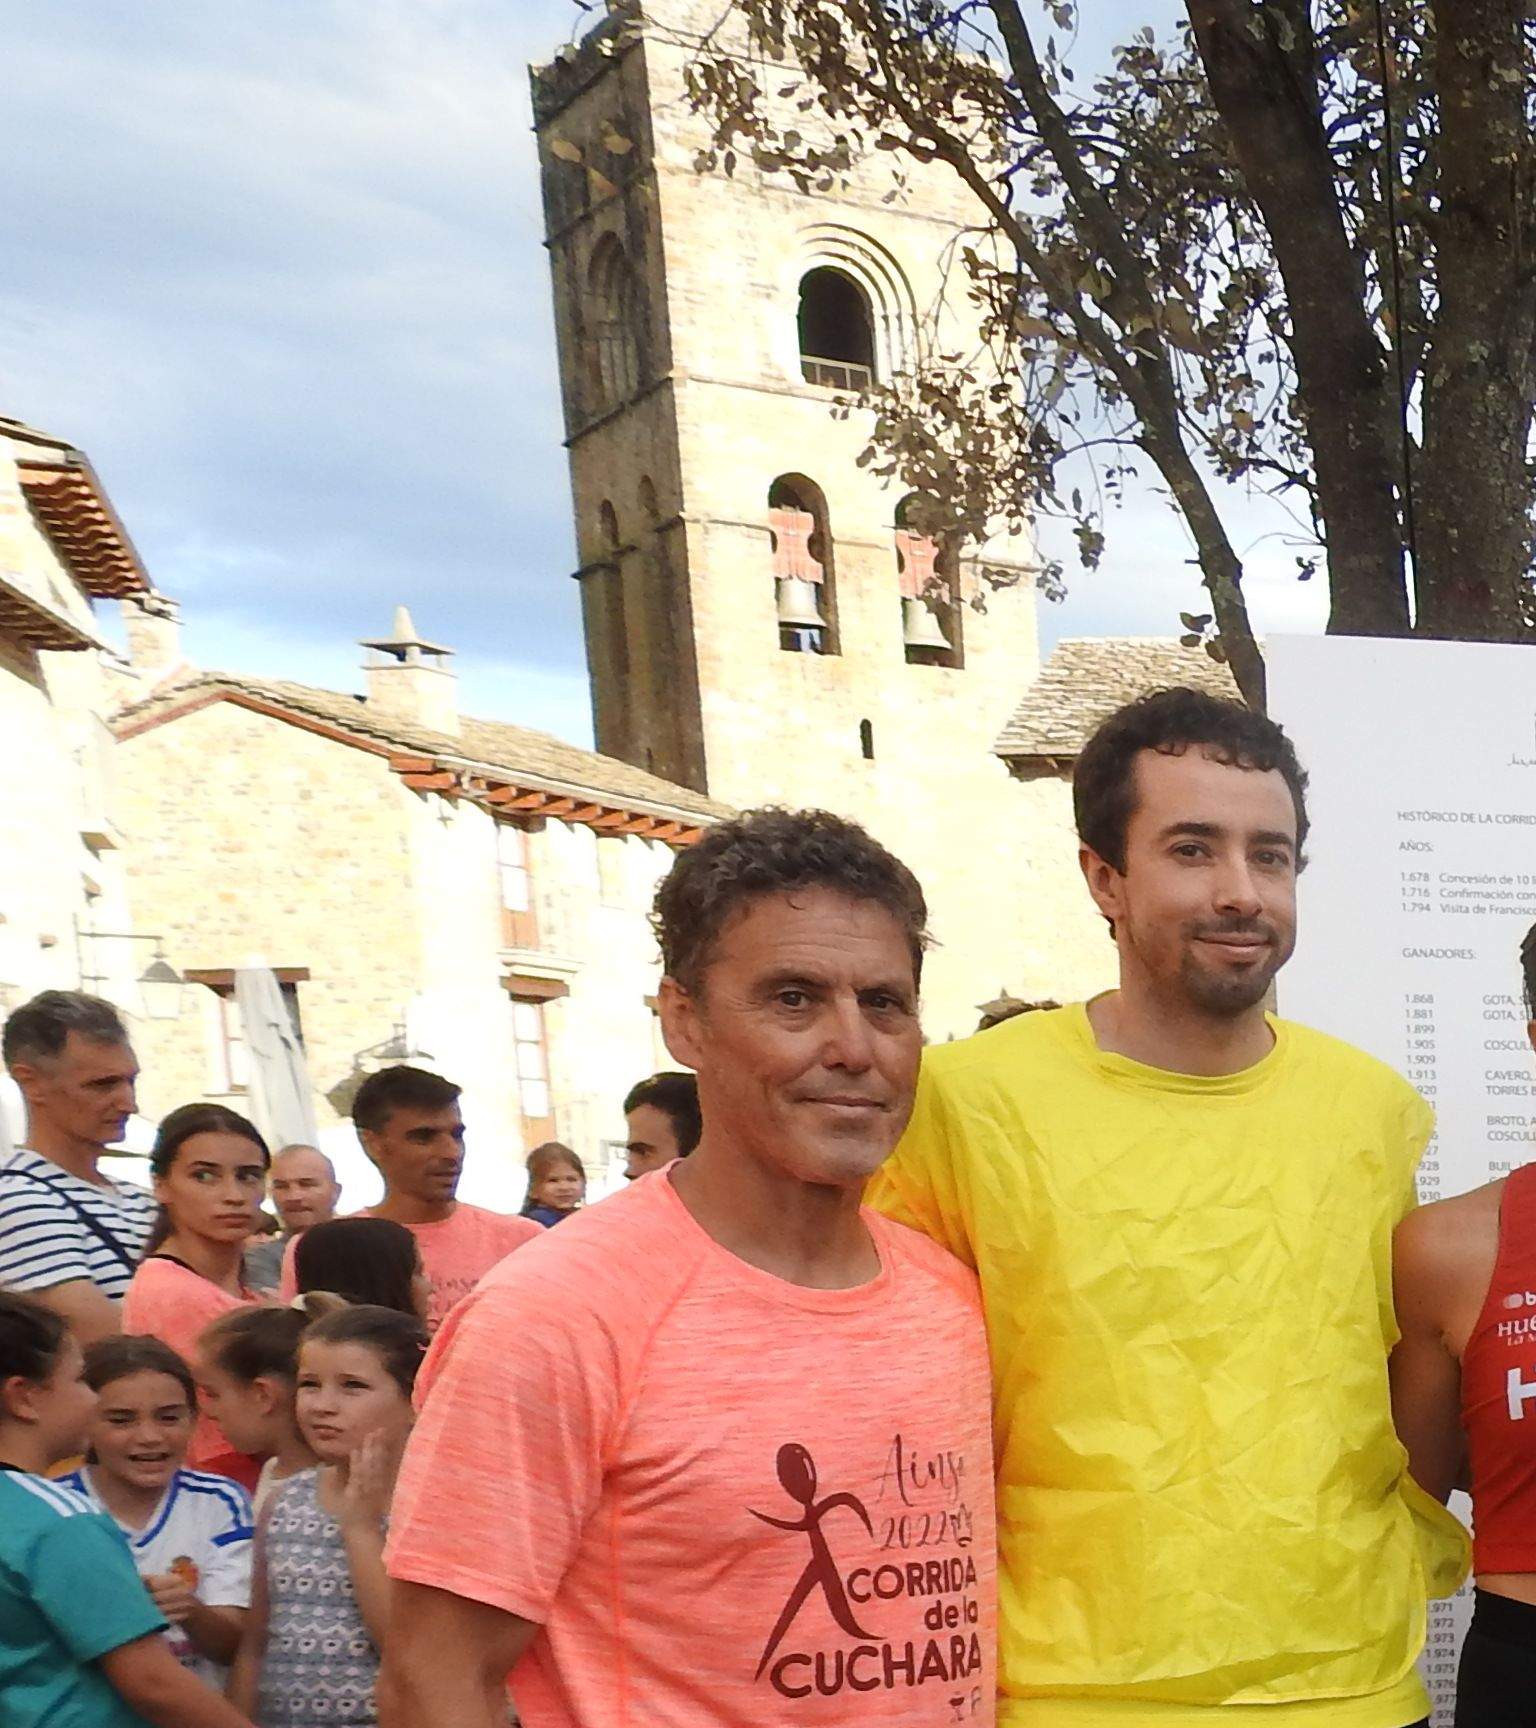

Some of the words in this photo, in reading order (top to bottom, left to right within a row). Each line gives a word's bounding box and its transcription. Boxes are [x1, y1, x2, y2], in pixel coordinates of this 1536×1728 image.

[1397, 810, 1458, 822] HISTÓRICO
[1460, 812, 1475, 822] DE
[1478, 813, 1492, 823] LA
[1398, 840, 1433, 851] AÑOS:
[1400, 871, 1430, 882] 1.678
[1438, 872, 1497, 884] Concesión
[1499, 874, 1514, 884] de
[1516, 875, 1527, 885] 10
[1401, 886, 1430, 897] 1.716
[1439, 887, 1513, 899] Confirmación
[1402, 902, 1430, 911] 1.794
[1440, 903, 1469, 913] Visita
[1472, 903, 1486, 913] de
[880, 1512, 949, 1552] 2022
[847, 1554, 978, 1603] CORRIDA
[924, 1600, 958, 1631] de
[963, 1595, 978, 1624] la
[770, 1632, 982, 1698] CUCHARA
